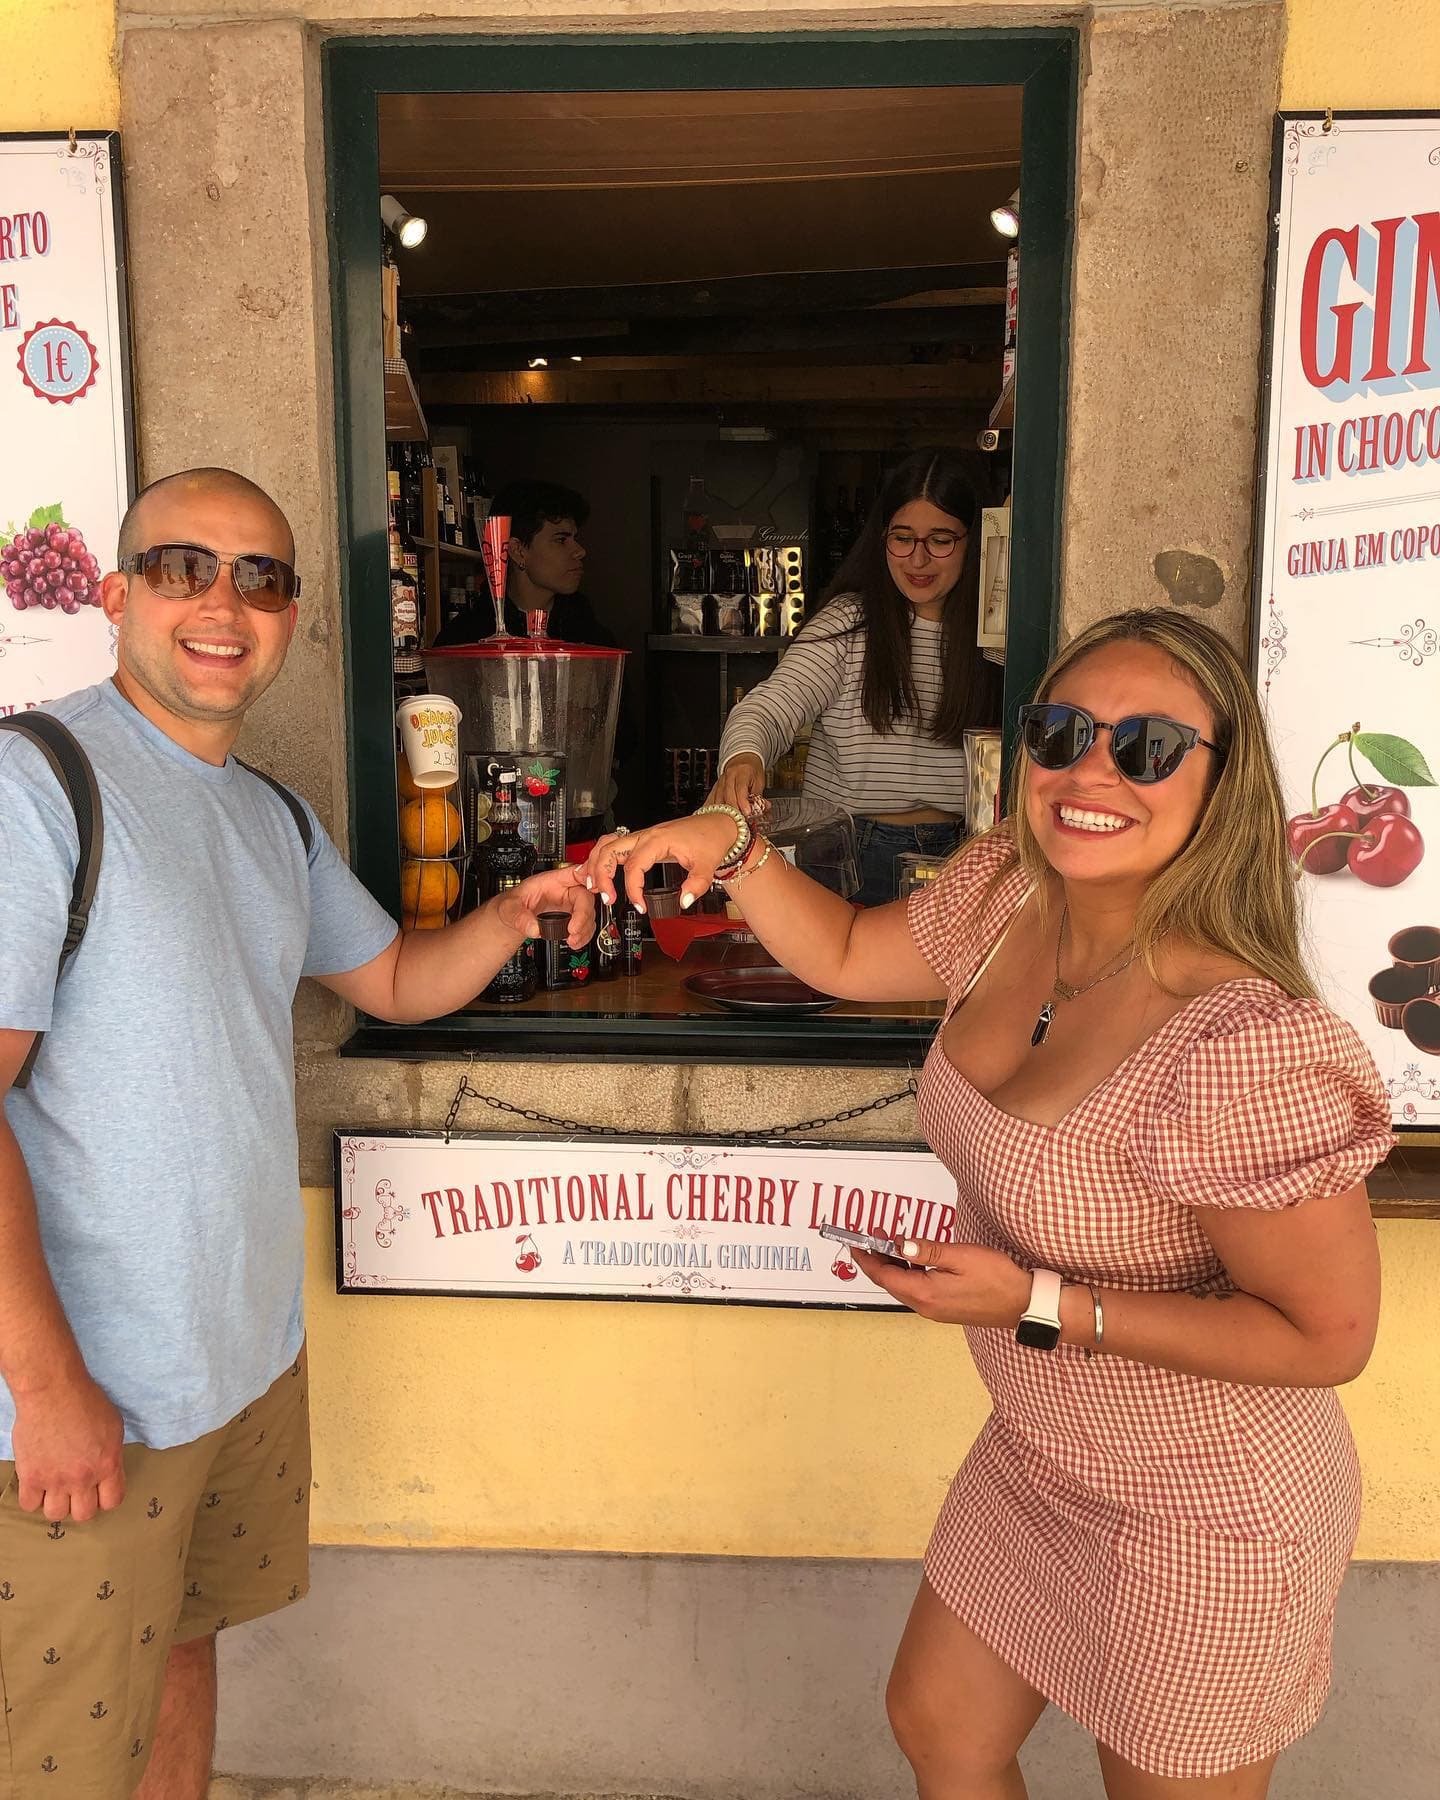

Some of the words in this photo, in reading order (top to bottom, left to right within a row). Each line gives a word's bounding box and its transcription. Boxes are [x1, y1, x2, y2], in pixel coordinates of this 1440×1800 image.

[43, 341, 73, 383] 1€
[1292, 422, 1334, 484] IN
[1337, 405, 1440, 477] CHOCO
[1287, 538, 1349, 578] GINJA
[1353, 532, 1387, 570] EM
[1390, 524, 1440, 566] COPO
[421, 1173, 654, 1239] TRADITIONAL
[666, 1173, 800, 1227] CHERRY
[562, 1240, 576, 1266] A
[580, 1241, 713, 1268] TRADICIONAL
[716, 1243, 814, 1272] GINJINHA
